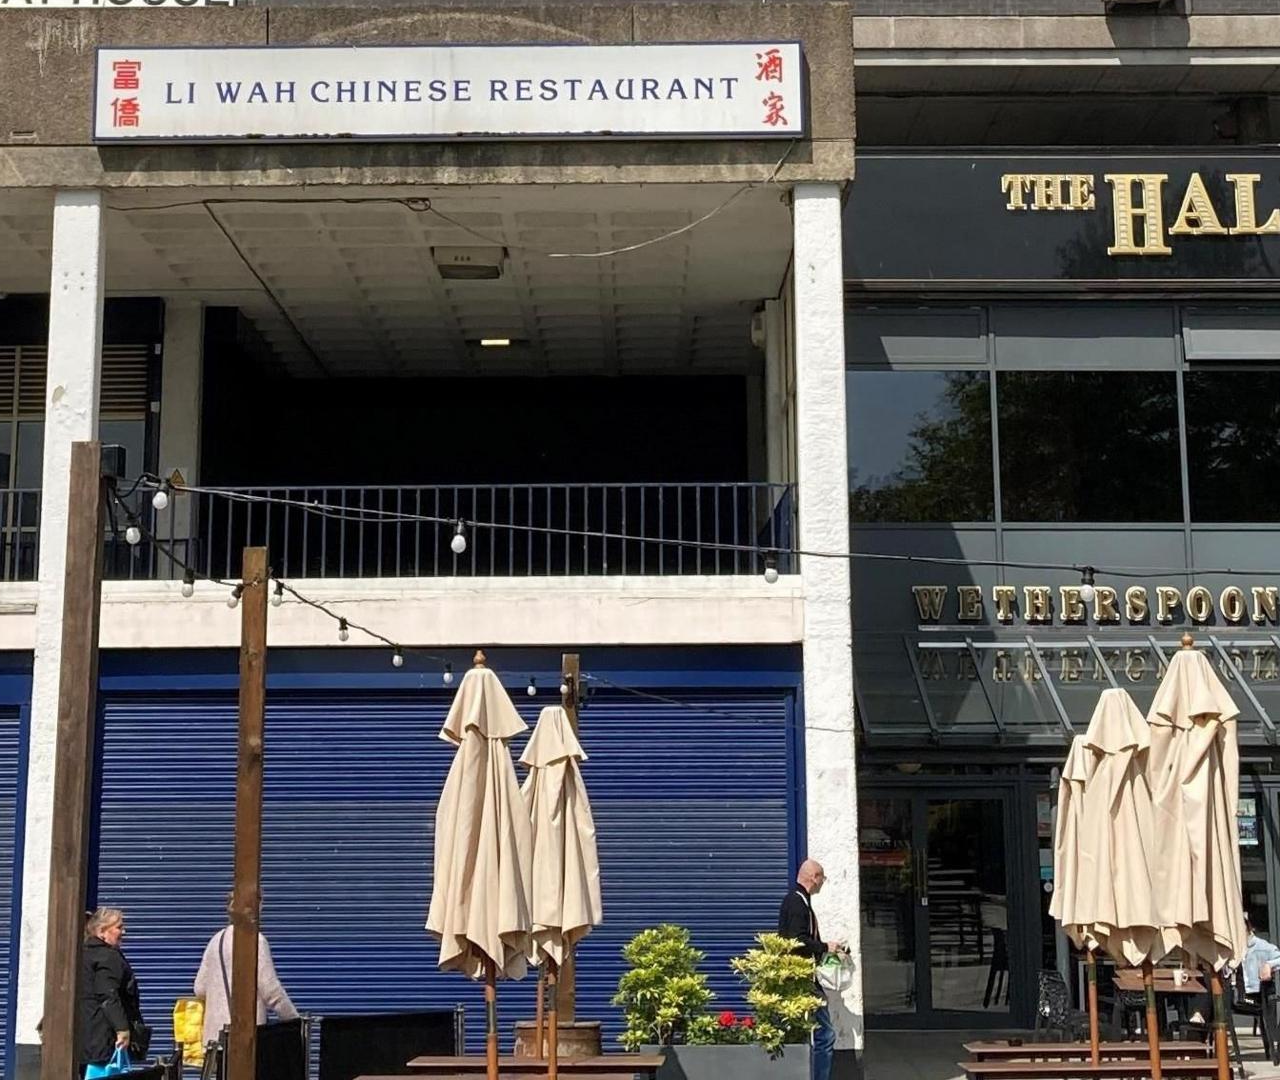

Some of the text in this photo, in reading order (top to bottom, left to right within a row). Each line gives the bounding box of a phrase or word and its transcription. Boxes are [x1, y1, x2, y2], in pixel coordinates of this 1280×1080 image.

[110, 59, 141, 128] 富僑
[166, 76, 740, 104] LI WAH CHINESE RESTAURANT
[756, 48, 789, 127] 酒家
[1001, 174, 1095, 210] THE
[911, 585, 1280, 622] WETHERSPOON
